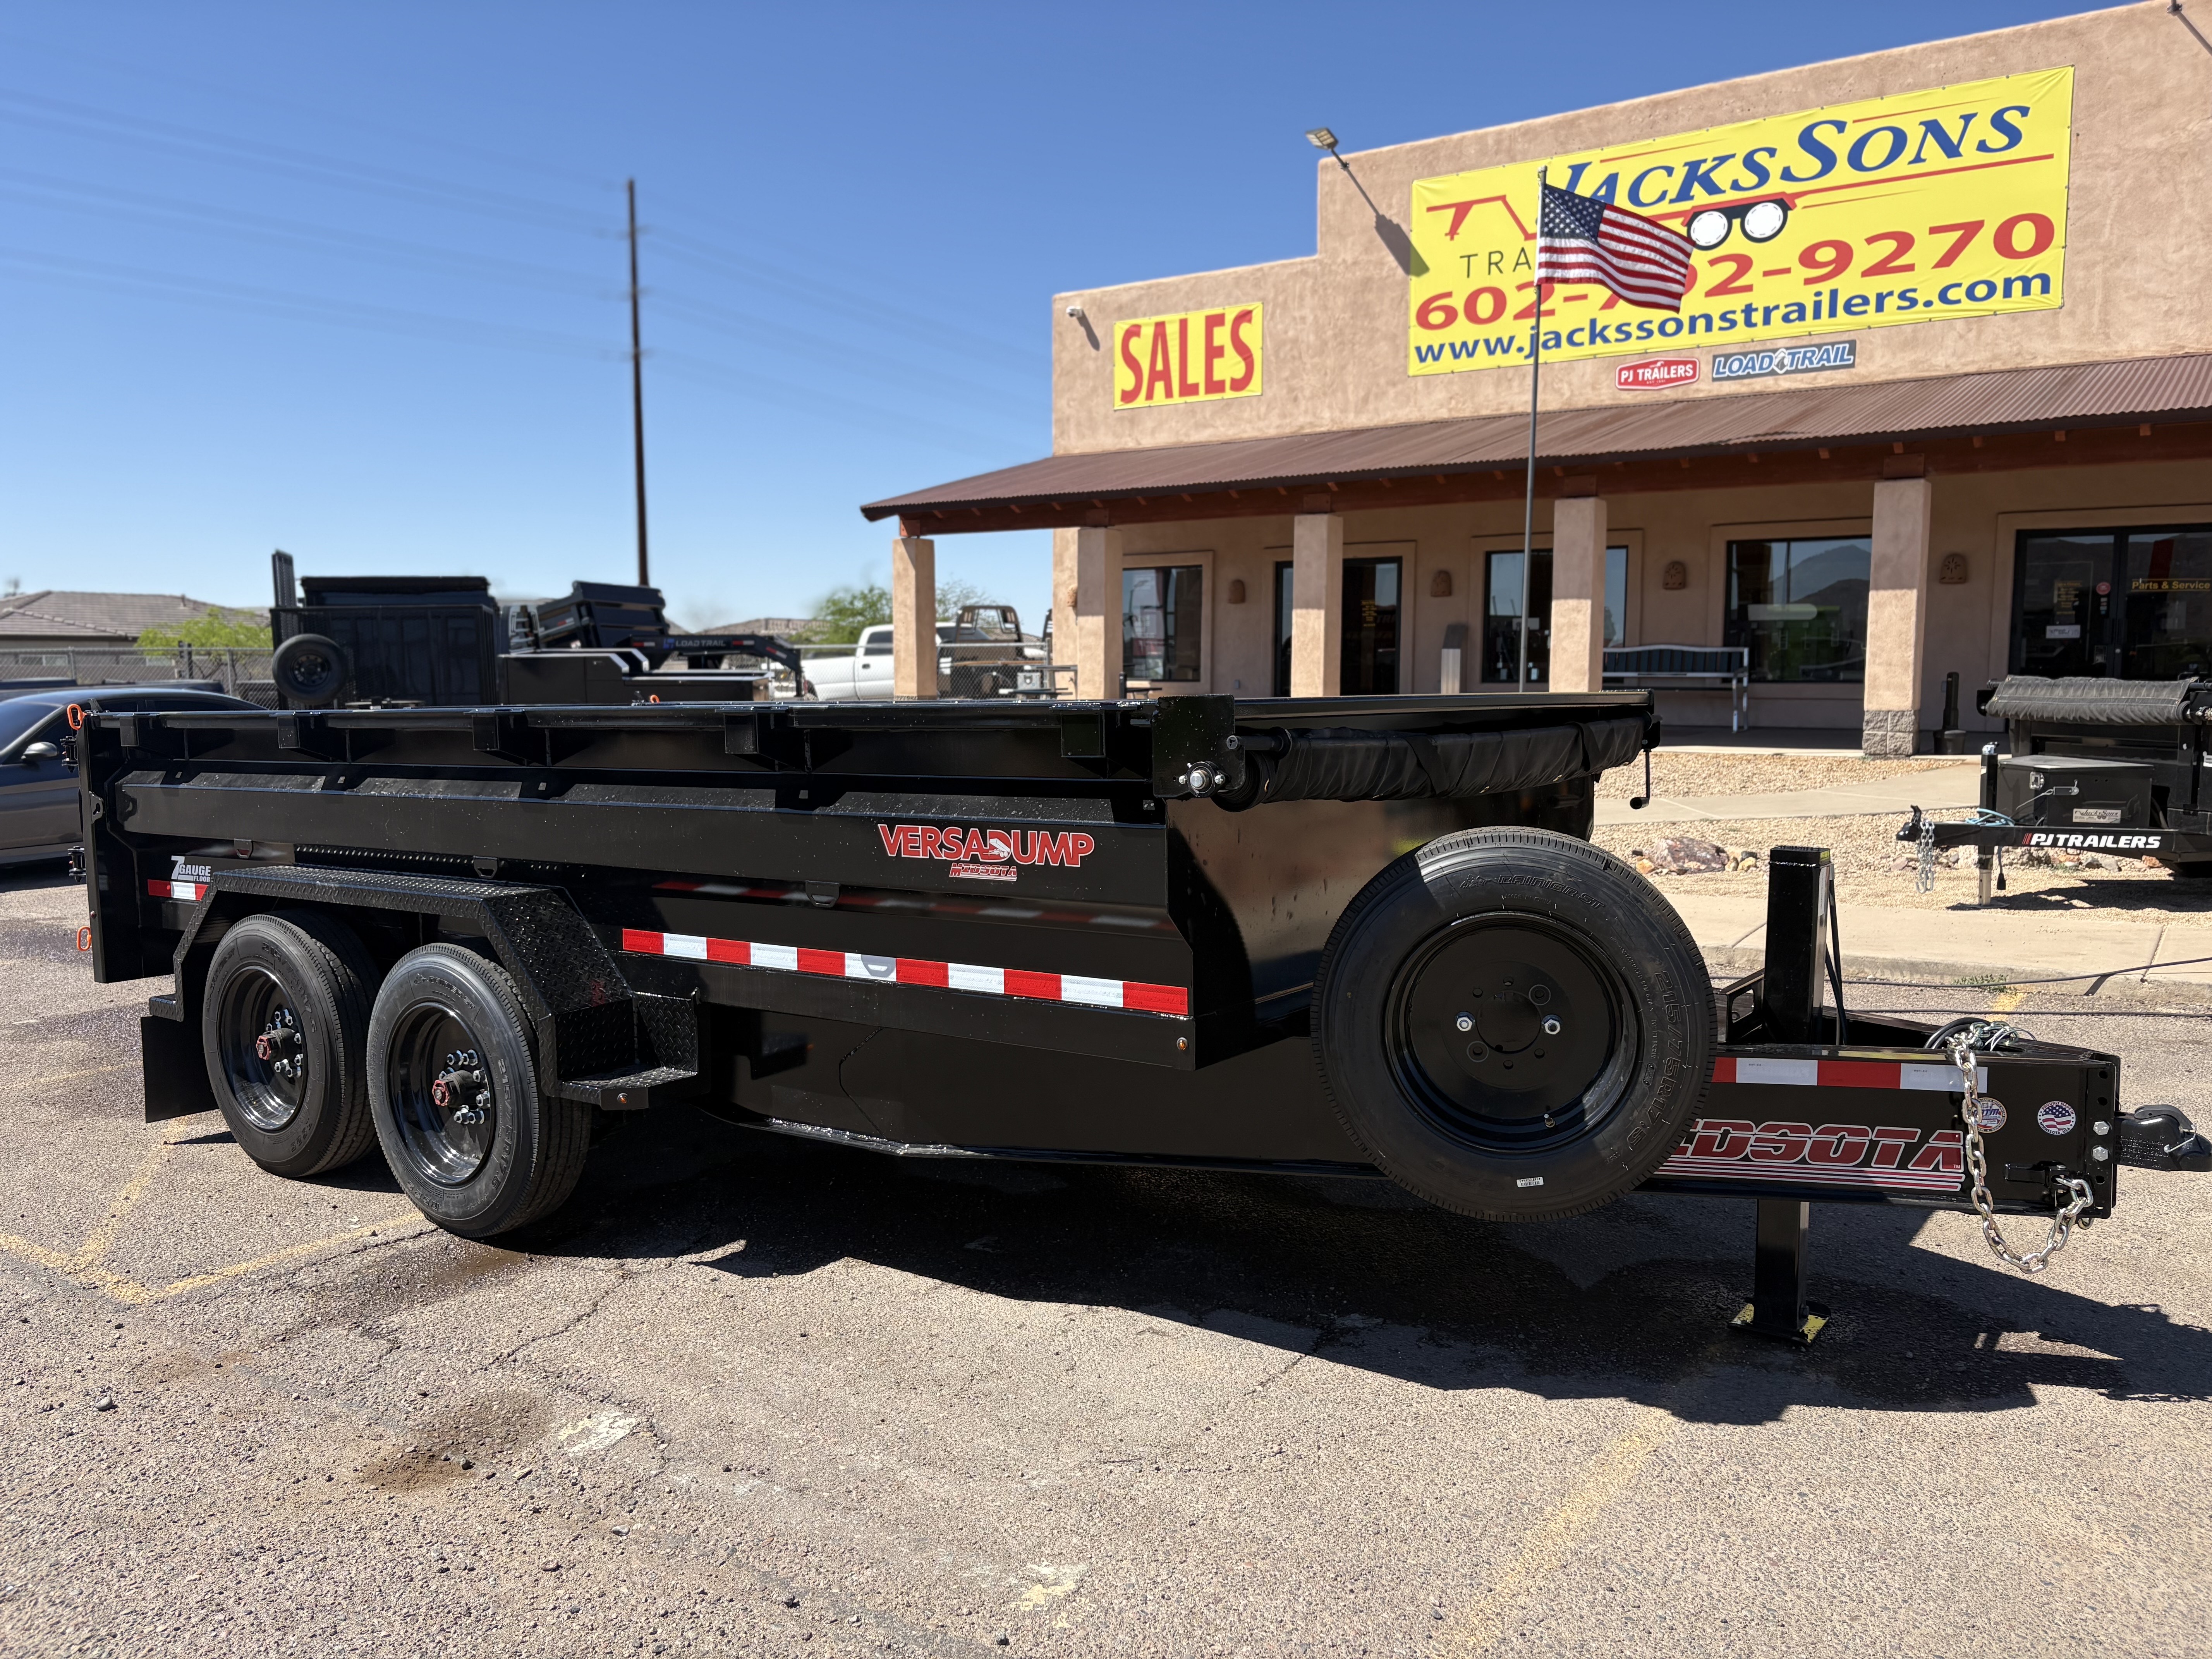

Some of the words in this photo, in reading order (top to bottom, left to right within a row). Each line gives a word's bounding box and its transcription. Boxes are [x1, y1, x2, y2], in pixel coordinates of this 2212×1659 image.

[1414, 273, 2052, 363] www.jackssonstrailers.com
[1120, 309, 1254, 404] SALES
[1713, 354, 1774, 378] LOAD
[1786, 343, 1854, 370] TRAIL
[1621, 370, 1633, 383] PJ
[1637, 364, 1693, 381] TRAILERS
[2132, 581, 2159, 590] Parts
[2172, 580, 2210, 589] Service
[2030, 833, 2056, 847] PJ
[2056, 834, 2161, 848] TRAILERS
[171, 855, 185, 880] 7
[179, 864, 211, 876] GAUGE
[949, 862, 1017, 878] MIDSOTA
[2042, 1101, 2059, 1110] PROUDLY
[2061, 1102, 2071, 1110] MADE
